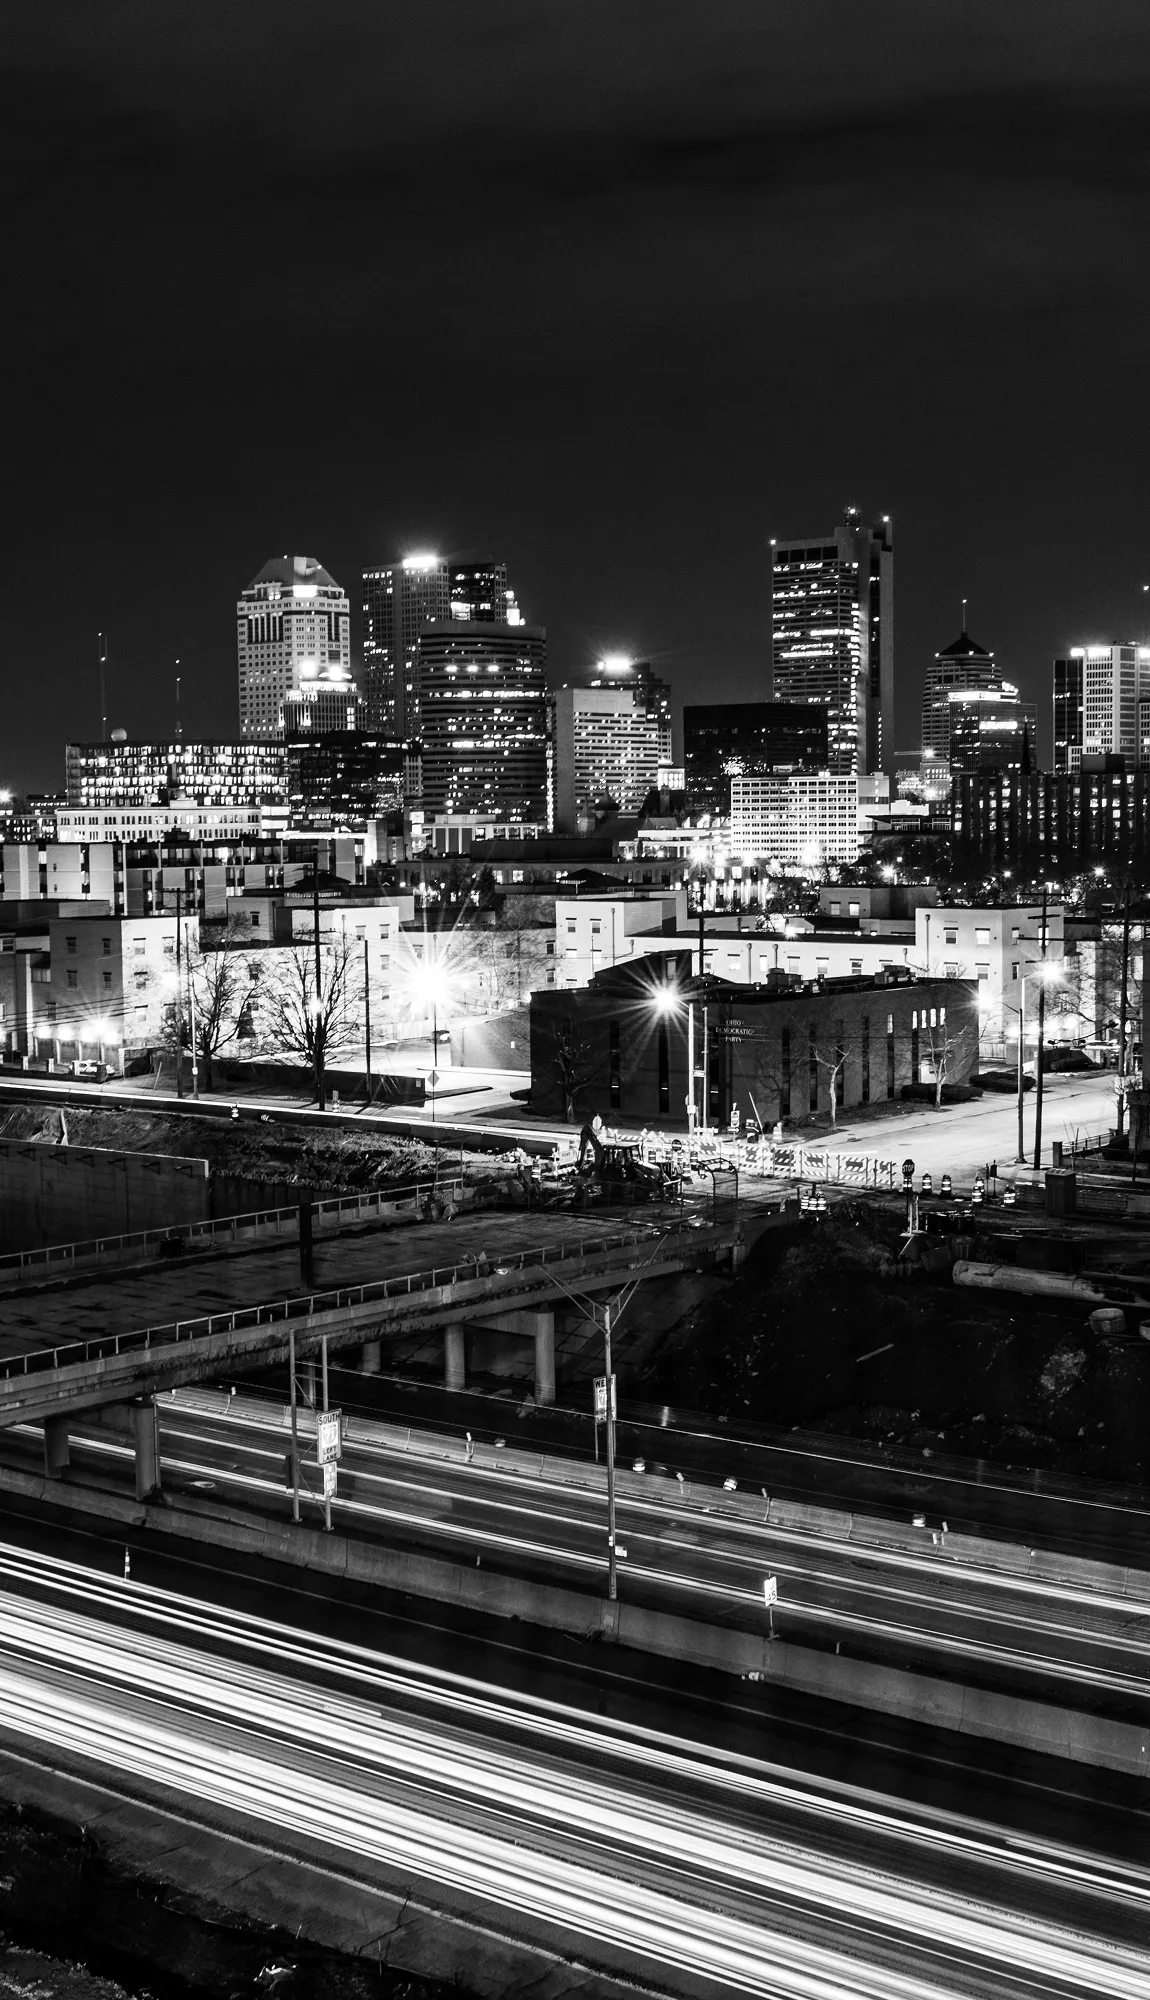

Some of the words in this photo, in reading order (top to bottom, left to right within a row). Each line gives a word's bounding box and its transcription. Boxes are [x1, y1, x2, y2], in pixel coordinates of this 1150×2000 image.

[716, 1027, 753, 1035] DEMOCRATIC
[902, 1164, 914, 1172] STOP
[319, 1413, 340, 1425] SOUTH
[323, 1445, 337, 1455] LEFT
[323, 1452, 338, 1462] LANE
